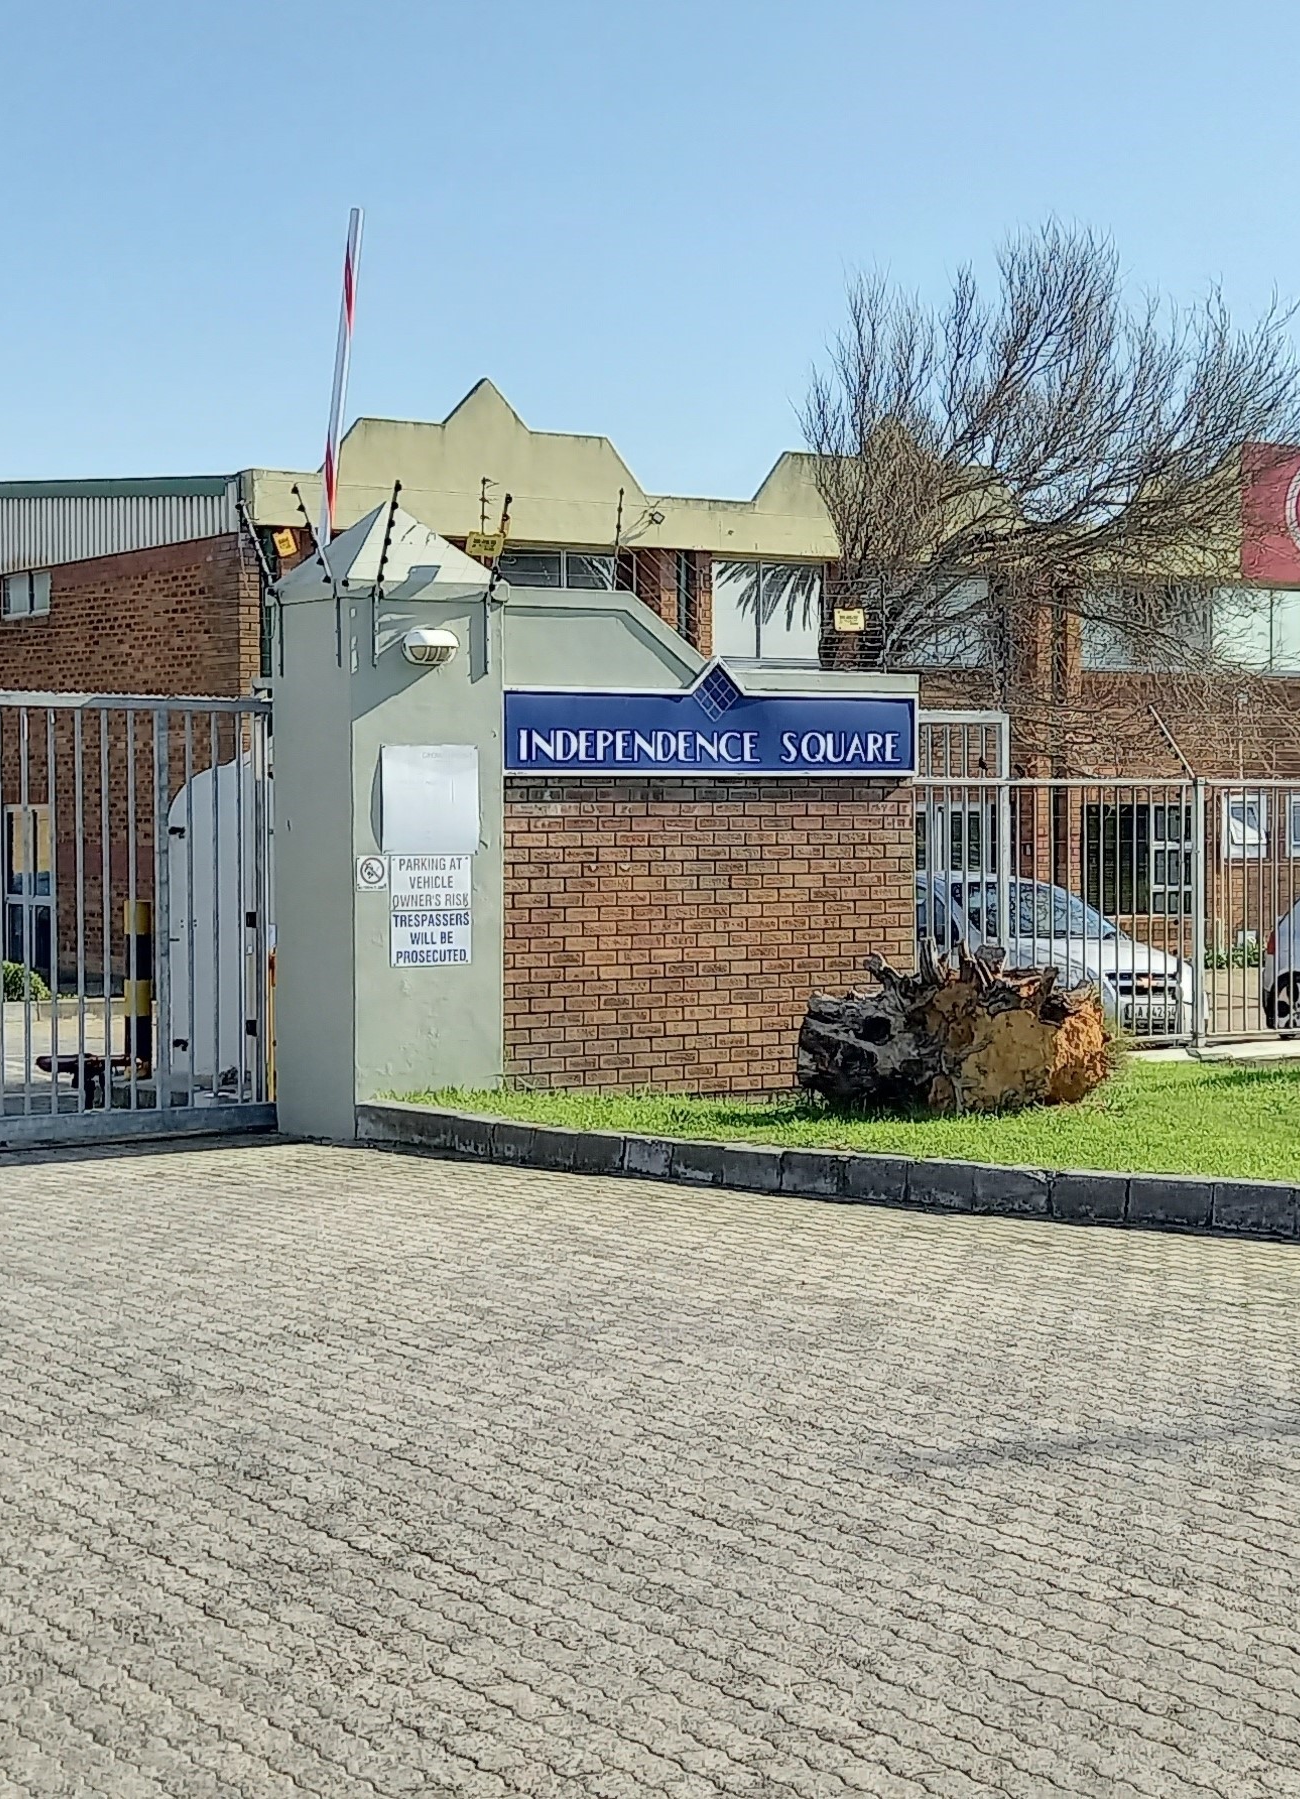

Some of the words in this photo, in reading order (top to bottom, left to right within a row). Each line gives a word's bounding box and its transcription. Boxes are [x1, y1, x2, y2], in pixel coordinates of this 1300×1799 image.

[518, 728, 760, 763] INDEPENDENCE
[781, 731, 902, 764] SQUARE
[399, 858, 446, 871] PARKING
[449, 857, 462, 870] AT
[409, 875, 454, 889] VEHICLE
[392, 894, 441, 908] OWNER'S
[445, 893, 469, 907] RISK
[393, 913, 469, 928] TRESPASSERS
[410, 932, 437, 945] WILL
[440, 931, 453, 944] BE
